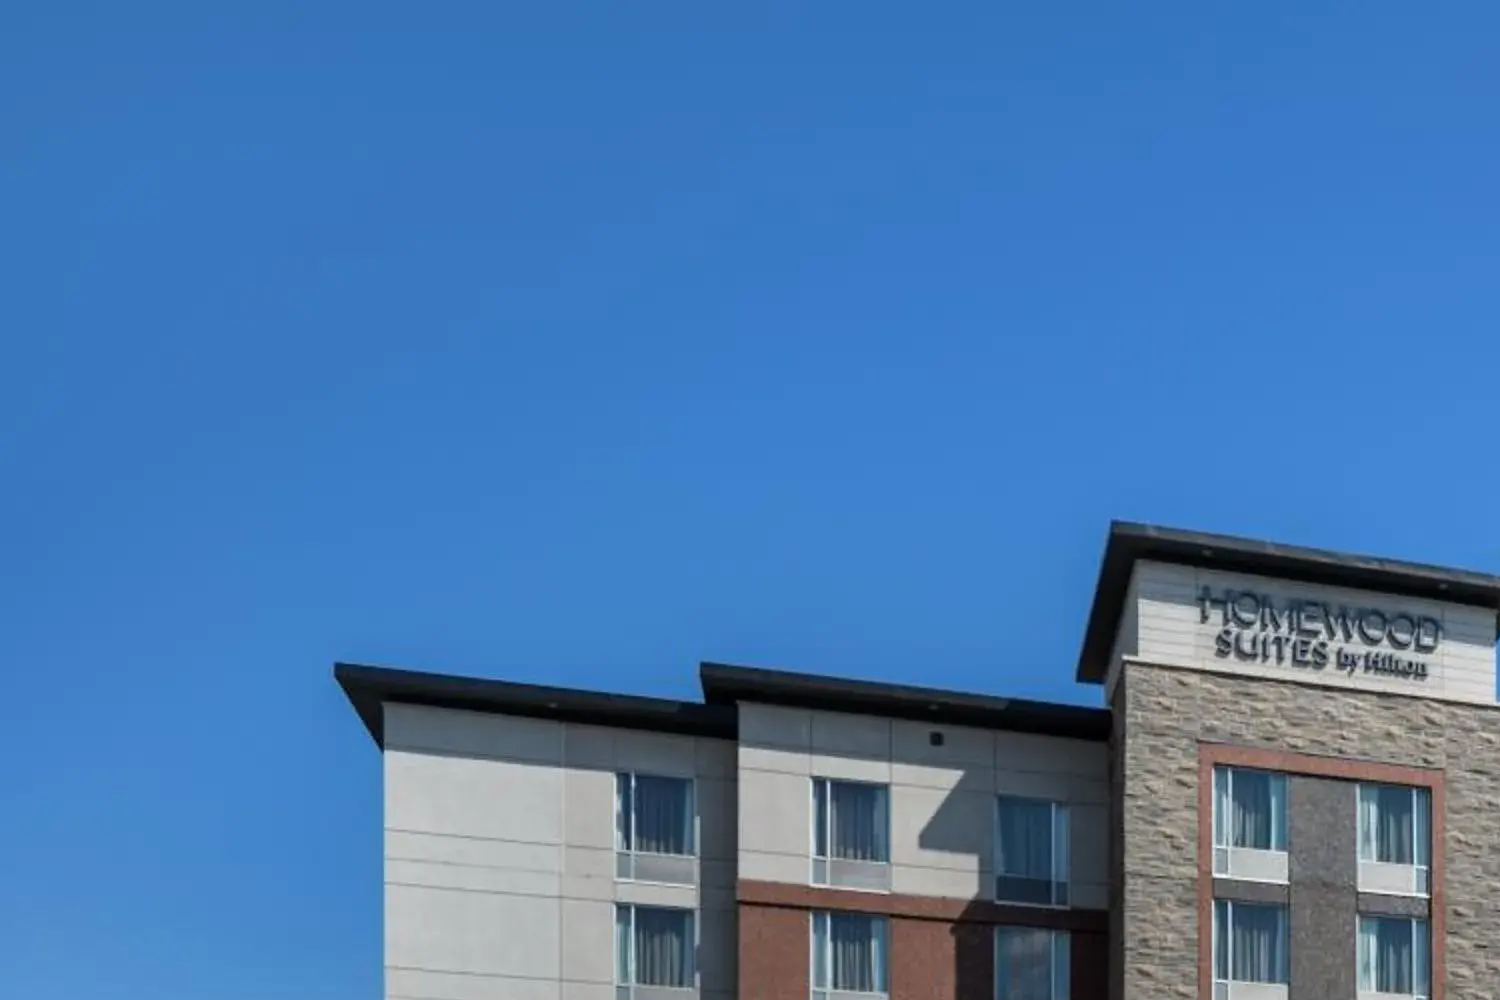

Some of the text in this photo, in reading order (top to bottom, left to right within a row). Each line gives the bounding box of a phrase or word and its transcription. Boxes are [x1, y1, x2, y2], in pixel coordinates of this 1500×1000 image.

[1199, 585, 1440, 653] HOMEWOOD
[1215, 628, 1428, 681] SUITES by Hilton
